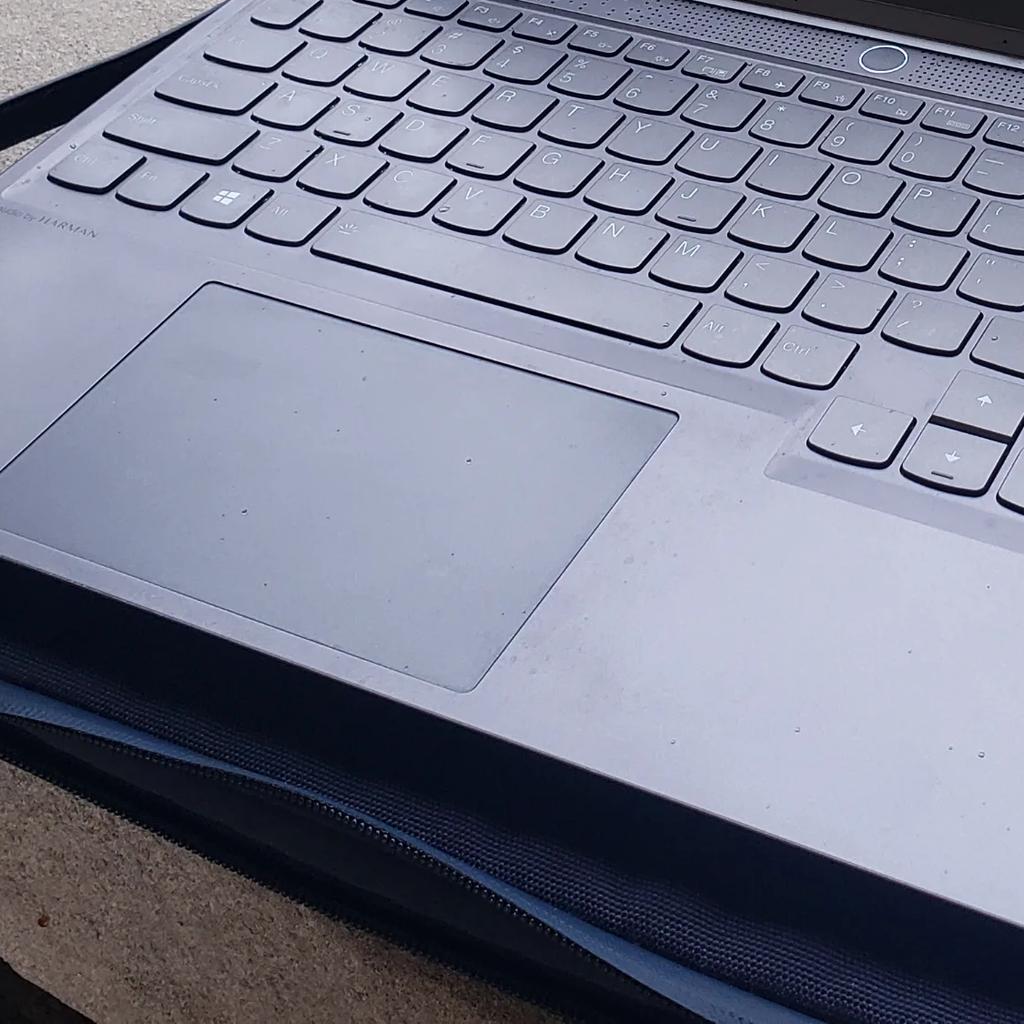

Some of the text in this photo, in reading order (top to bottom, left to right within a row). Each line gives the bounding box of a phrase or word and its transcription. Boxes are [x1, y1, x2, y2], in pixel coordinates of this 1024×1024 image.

[528, 17, 544, 26] F4
[583, 29, 600, 39] F5
[640, 42, 655, 52] F6
[369, 59, 397, 73] W
[697, 55, 714, 65] F7
[559, 72, 575, 84] 5
[754, 67, 771, 77] F8
[813, 80, 831, 90] F9
[279, 89, 297, 103] A
[496, 89, 516, 103] R
[625, 86, 640, 99] 6
[705, 88, 719, 101] &
[873, 94, 896, 105] F10
[341, 103, 357, 116] S
[567, 105, 584, 118] T
[693, 102, 706, 115] 7
[934, 107, 956, 118] F11
[406, 120, 424, 132] D
[634, 121, 651, 133] Y
[760, 118, 774, 131] 8
[997, 121, 1021, 133] F12
[266, 136, 283, 151] Z
[472, 134, 491, 147] F
[700, 138, 718, 152] U
[831, 135, 846, 148] 9
[325, 152, 344, 168] X
[541, 152, 561, 166] G
[900, 151, 916, 164] 0
[608, 168, 631, 183] H
[841, 171, 861, 185] O
[463, 188, 481, 202] V
[680, 187, 696, 200] J
[914, 187, 932, 201] P
[530, 204, 551, 219] B
[751, 203, 772, 218] K
[602, 222, 625, 238] N
[825, 221, 838, 236] L
[675, 241, 701, 257] M
